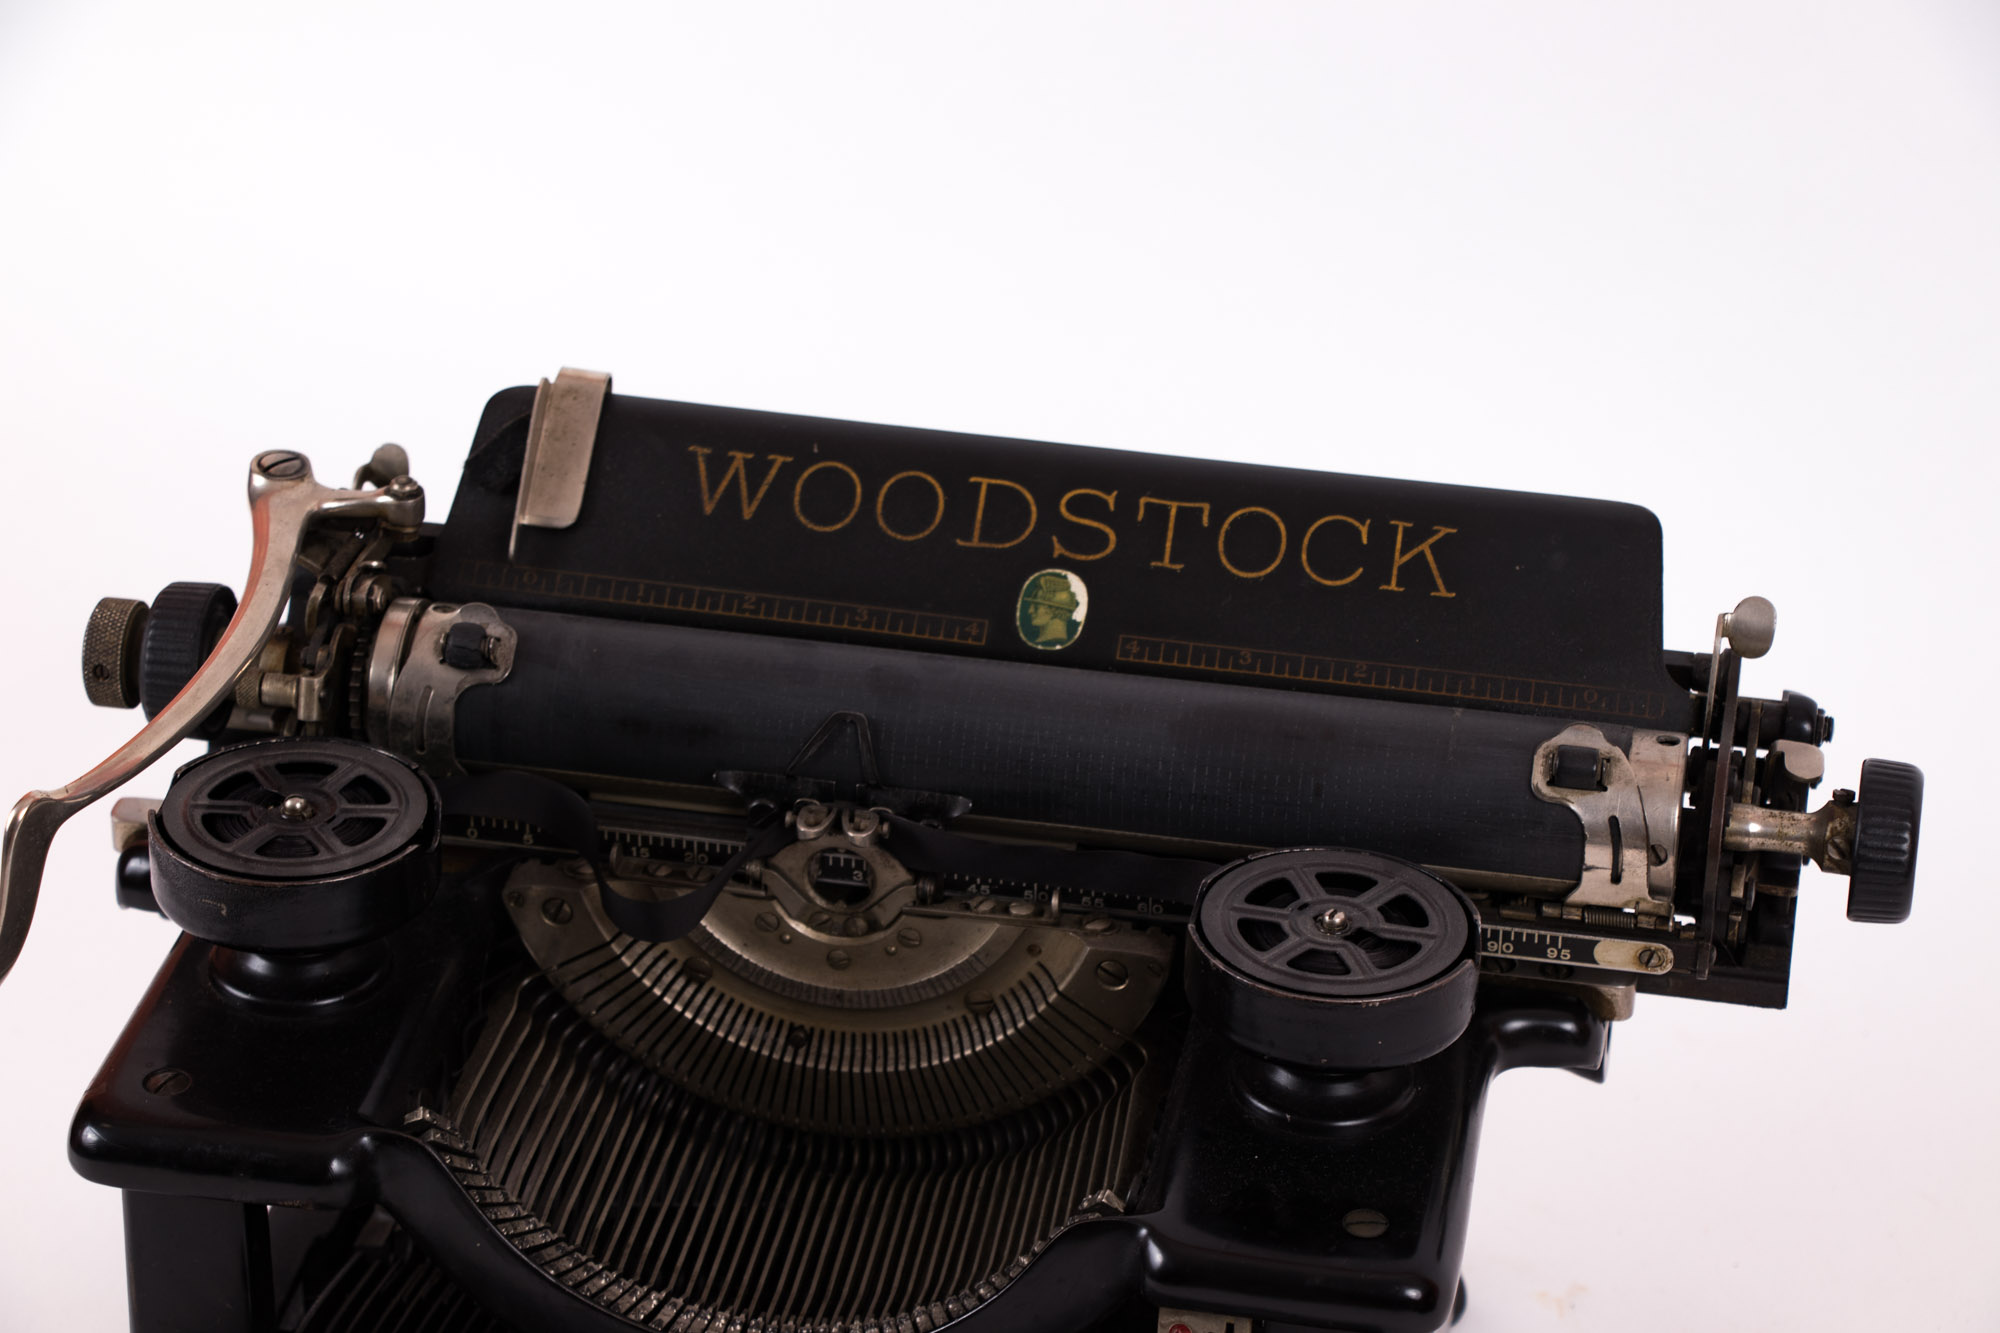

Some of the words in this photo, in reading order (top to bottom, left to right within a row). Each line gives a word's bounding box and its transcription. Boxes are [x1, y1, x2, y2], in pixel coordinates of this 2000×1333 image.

[688, 444, 1458, 597] WOODSTOCK
[743, 593, 757, 609] 2
[855, 607, 869, 622] 3
[964, 622, 980, 636] 4
[1124, 639, 1140, 654] 4
[1239, 650, 1253, 665] 3
[1353, 663, 1368, 678] 2
[466, 827, 479, 839] 0
[523, 834, 535, 846] 5
[630, 845, 650, 858] 15
[683, 850, 710, 865] 20
[967, 883, 991, 896] 45
[1023, 889, 1049, 903] 50
[1081, 895, 1105, 909] 55
[1137, 901, 1164, 915] 60
[1486, 940, 1515, 954] 90
[1546, 946, 1572, 961] 95
